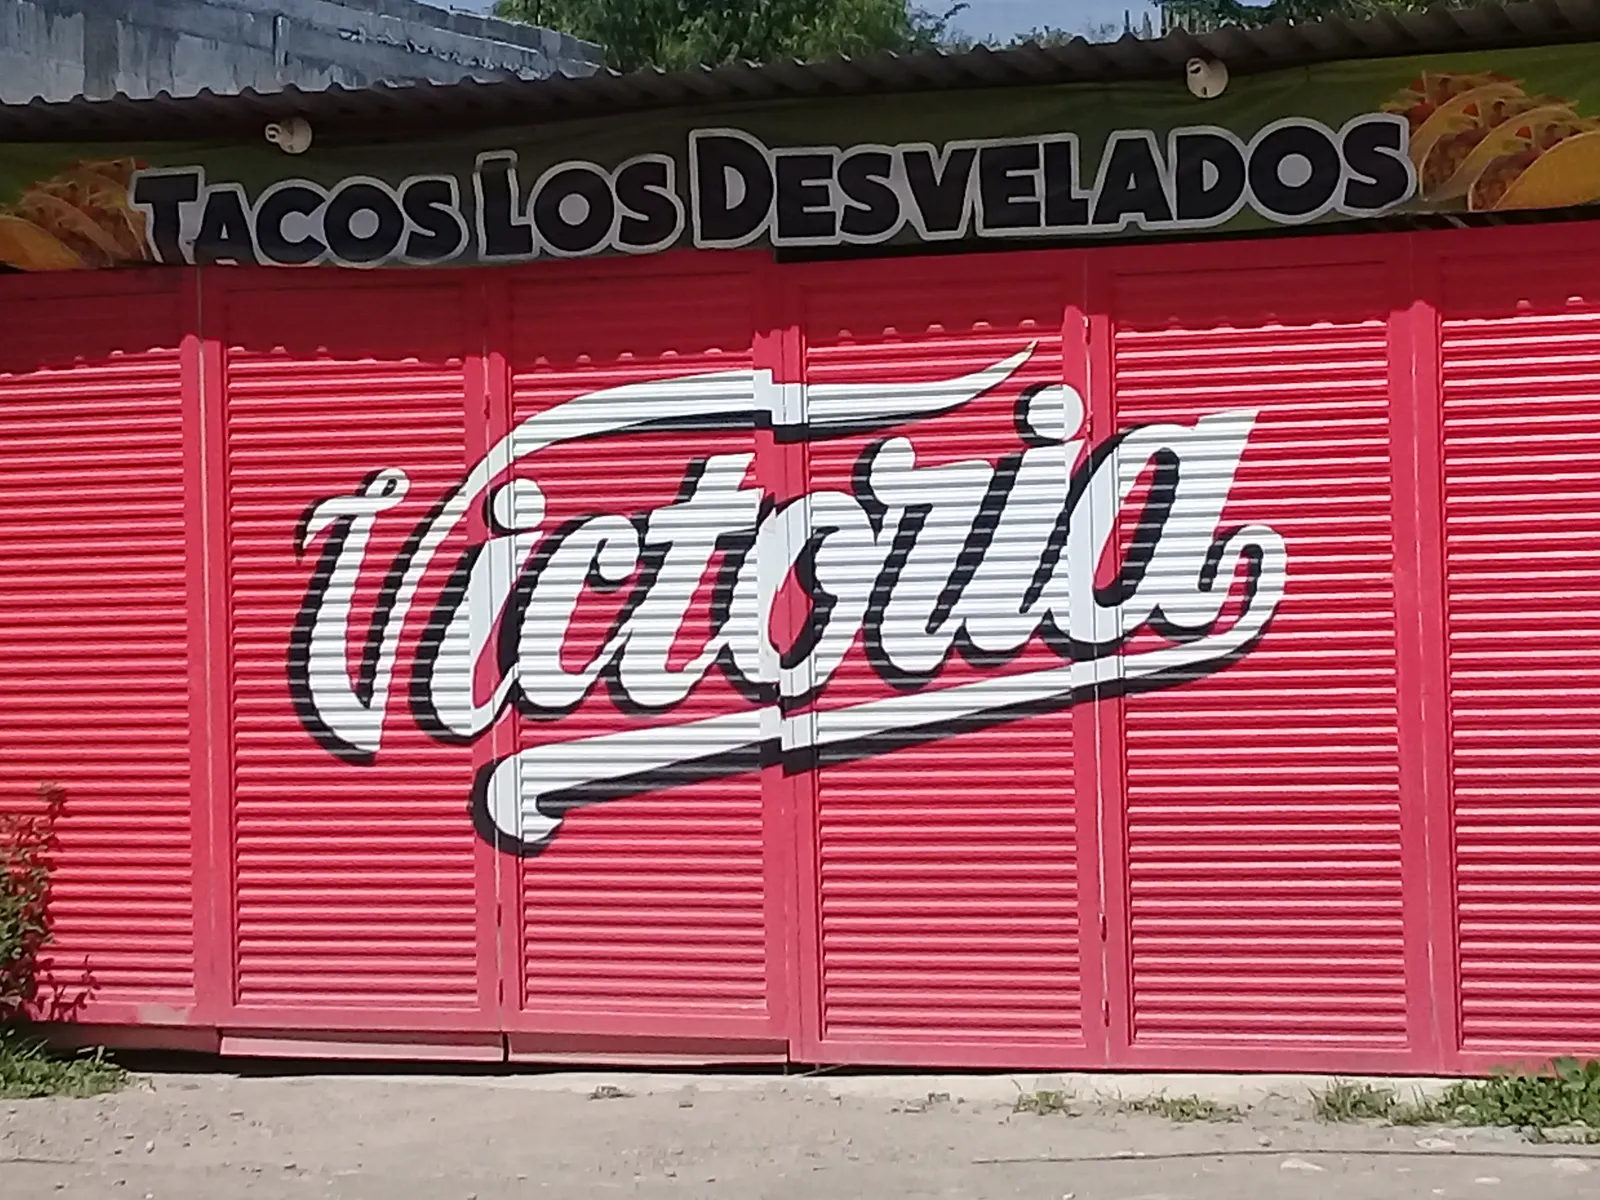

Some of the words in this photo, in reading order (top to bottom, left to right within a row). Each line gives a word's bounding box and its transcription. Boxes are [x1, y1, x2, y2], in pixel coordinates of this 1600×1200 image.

[130, 167, 469, 267] TACOS
[474, 149, 686, 258] LOS
[688, 114, 1416, 250] DESVELADOS
[288, 341, 1288, 855] Victoria
